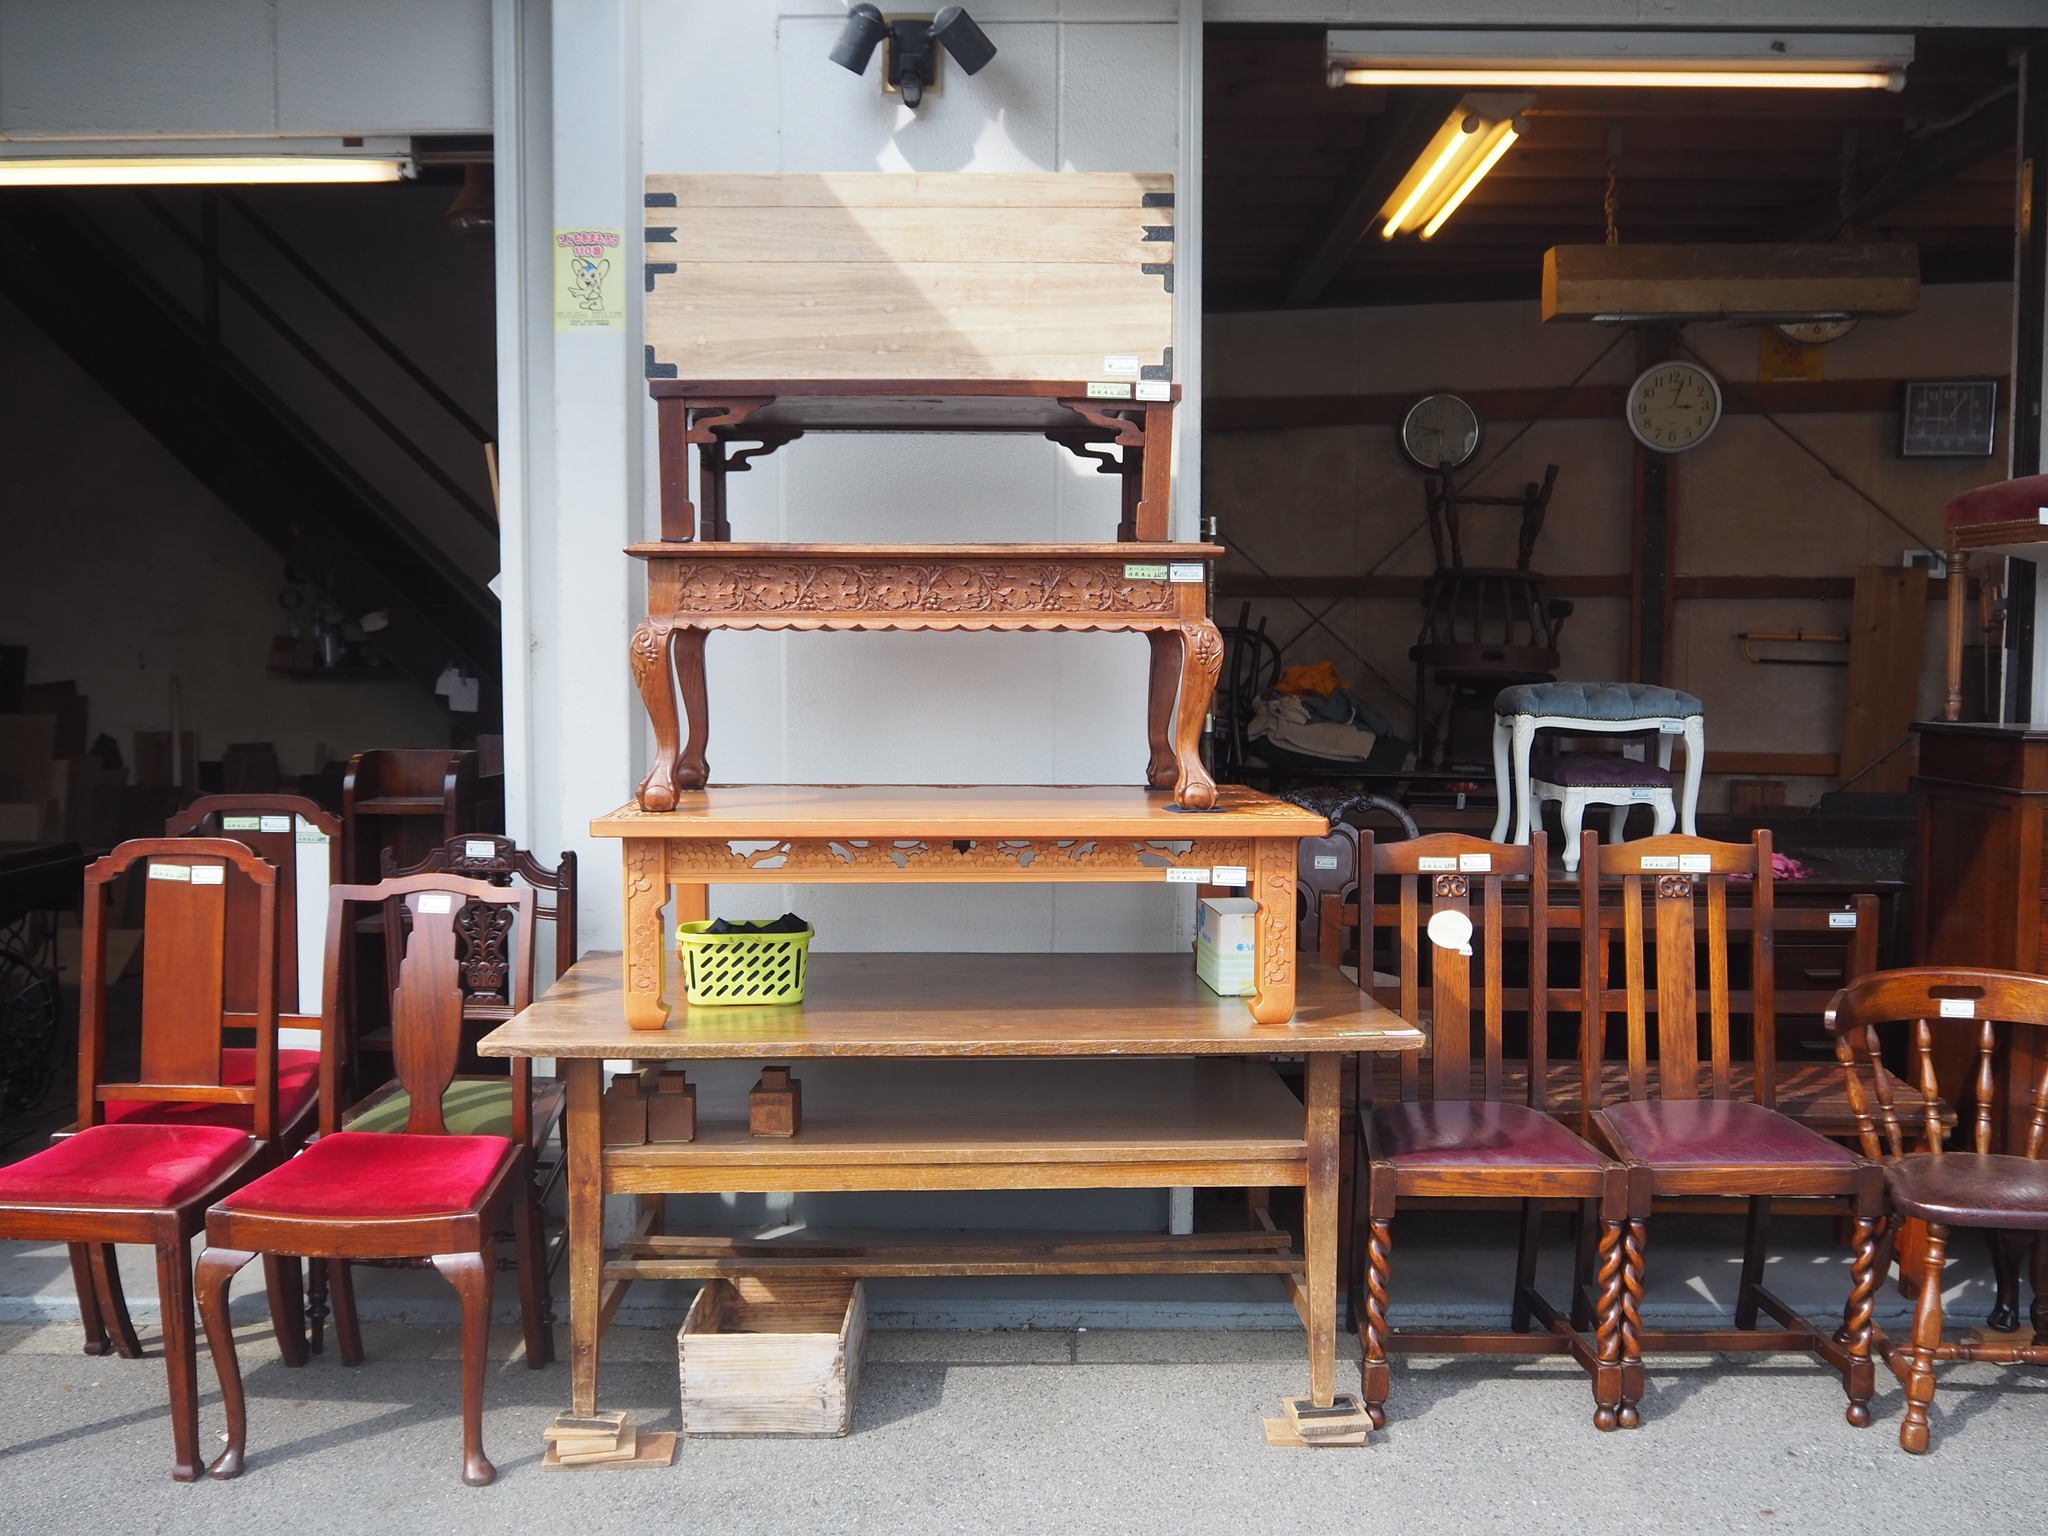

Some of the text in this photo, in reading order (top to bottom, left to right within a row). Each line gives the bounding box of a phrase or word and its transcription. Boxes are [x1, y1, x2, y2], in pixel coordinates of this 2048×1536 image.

[1655, 376, 1664, 387] 11
[1669, 371, 1680, 383] 12
[1688, 375, 1692, 386] 1
[1644, 387, 1655, 399] 10
[1697, 385, 1704, 397] 2
[1639, 403, 1647, 415] 9
[1701, 401, 1709, 412] 3
[1644, 418, 1651, 429] 8
[1655, 428, 1663, 439] 7
[1668, 431, 1676, 442] 6
[1685, 427, 1692, 438] 5
